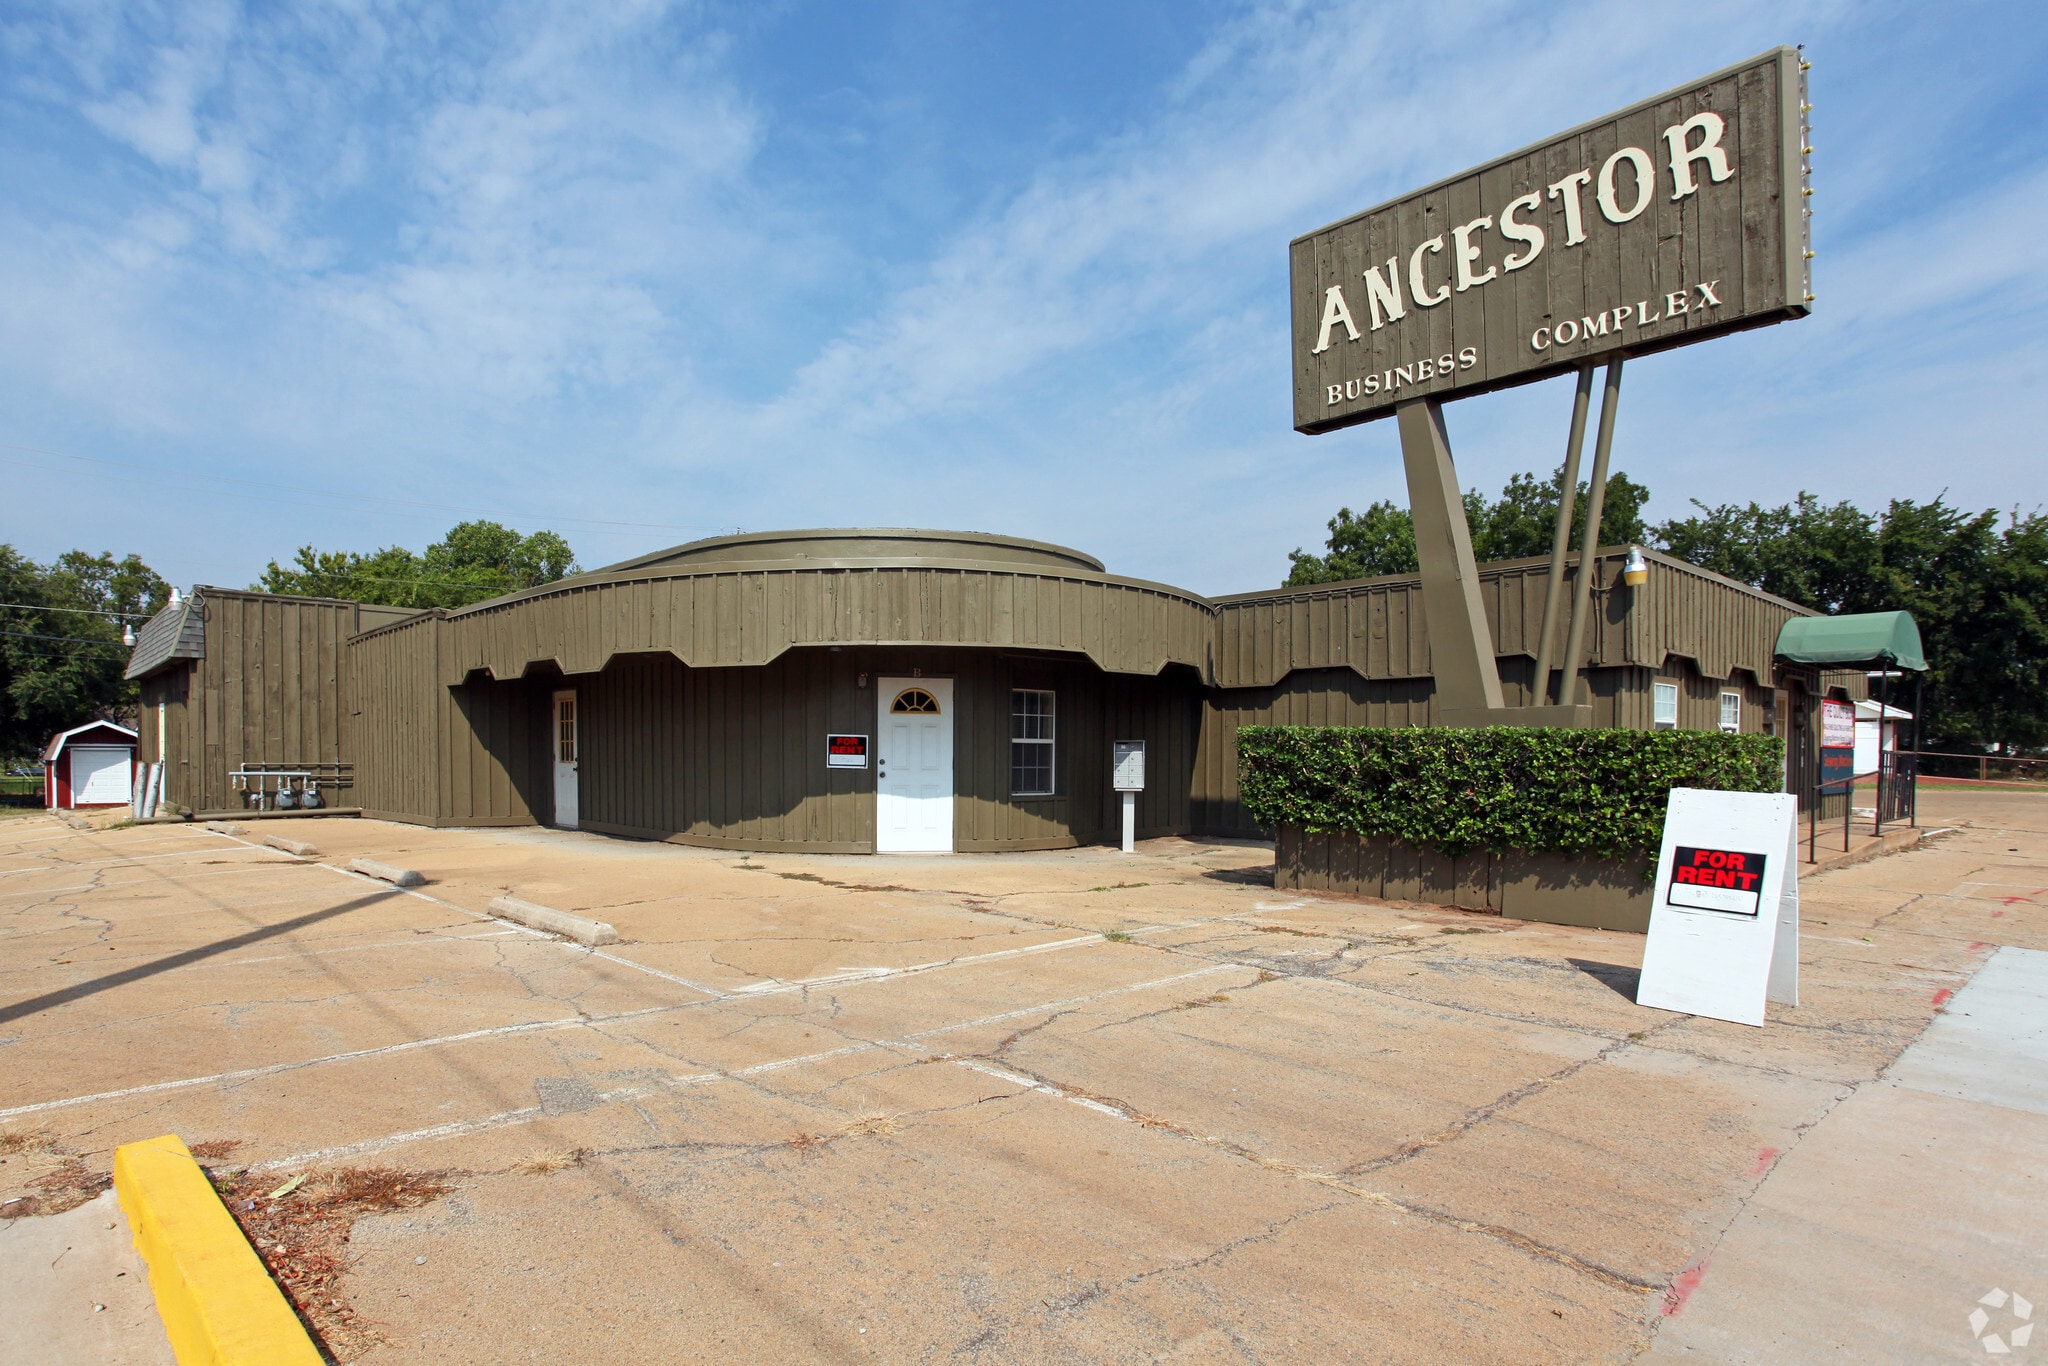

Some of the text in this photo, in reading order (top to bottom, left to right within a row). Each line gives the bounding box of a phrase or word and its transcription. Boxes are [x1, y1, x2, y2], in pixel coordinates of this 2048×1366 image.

[1312, 112, 1735, 354] ANCESTOR
[1326, 280, 1722, 406] BUSINESS COMPLEX
[831, 745, 864, 754] RENT
[836, 737, 858, 745] FOR
[1693, 850, 1746, 871] FOR
[1676, 865, 1758, 890] RENT
